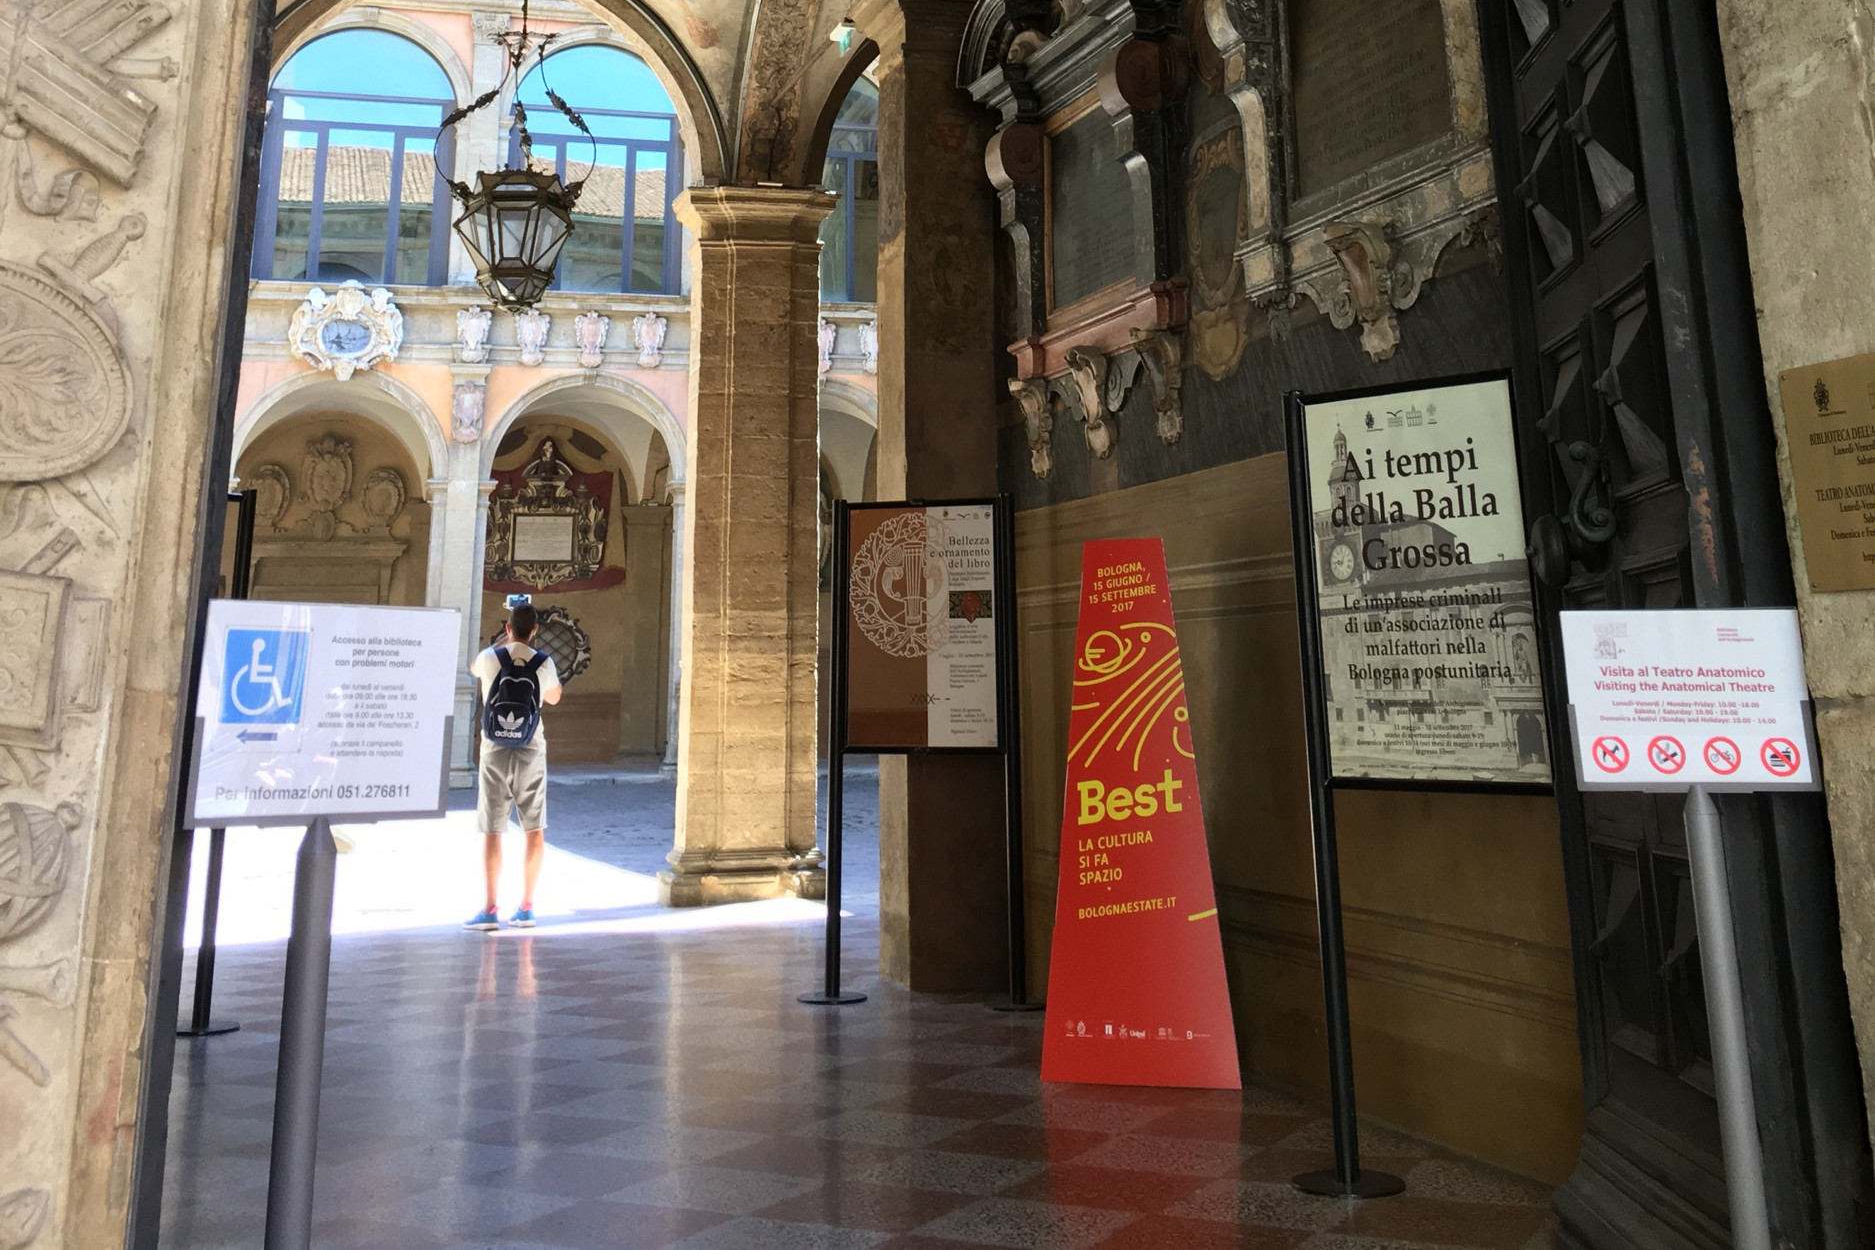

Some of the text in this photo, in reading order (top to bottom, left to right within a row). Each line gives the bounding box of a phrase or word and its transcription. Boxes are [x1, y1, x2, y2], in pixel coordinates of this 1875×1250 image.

[1809, 429, 1851, 446] BIBLIOTECA
[1341, 437, 1479, 484] Ai tempi
[1816, 487, 1843, 502] TEATRO
[1331, 483, 1500, 528] della Balla
[948, 535, 990, 546] Bellezza
[929, 548, 990, 558] e ornamento
[1362, 538, 1473, 571] Grossa
[948, 558, 991, 568] del libro
[1097, 561, 1146, 578] BOLOGNA,
[1093, 580, 1104, 591] 15
[1105, 574, 1143, 590] GIUGNO
[1088, 584, 1157, 605] 15 SETTEMBRE
[1342, 587, 1503, 614] Le imprese criminali
[1111, 601, 1134, 613] 2017
[1344, 611, 1506, 634] di un'associazione di
[331, 636, 422, 647] Accesso alla biblioteca
[1366, 636, 1487, 656] malfattori nella
[352, 649, 400, 658] per persone
[335, 659, 415, 668] con problemi motori
[1600, 666, 1765, 678] Visita al Teatro Anatomico
[1347, 660, 1512, 686] Bologna postunitaria
[1594, 681, 1775, 693] Visiting the Anatomical Theatre
[495, 730, 522, 738] adidas
[215, 784, 410, 800] Per informazioni 051.276811
[1077, 768, 1183, 826] Best
[1078, 830, 1153, 852] LA CULTURA
[1079, 853, 1109, 869] SI FA
[1079, 867, 1123, 886] SPAZIO
[1078, 896, 1177, 920] BOLOGNAESTATE.IT
